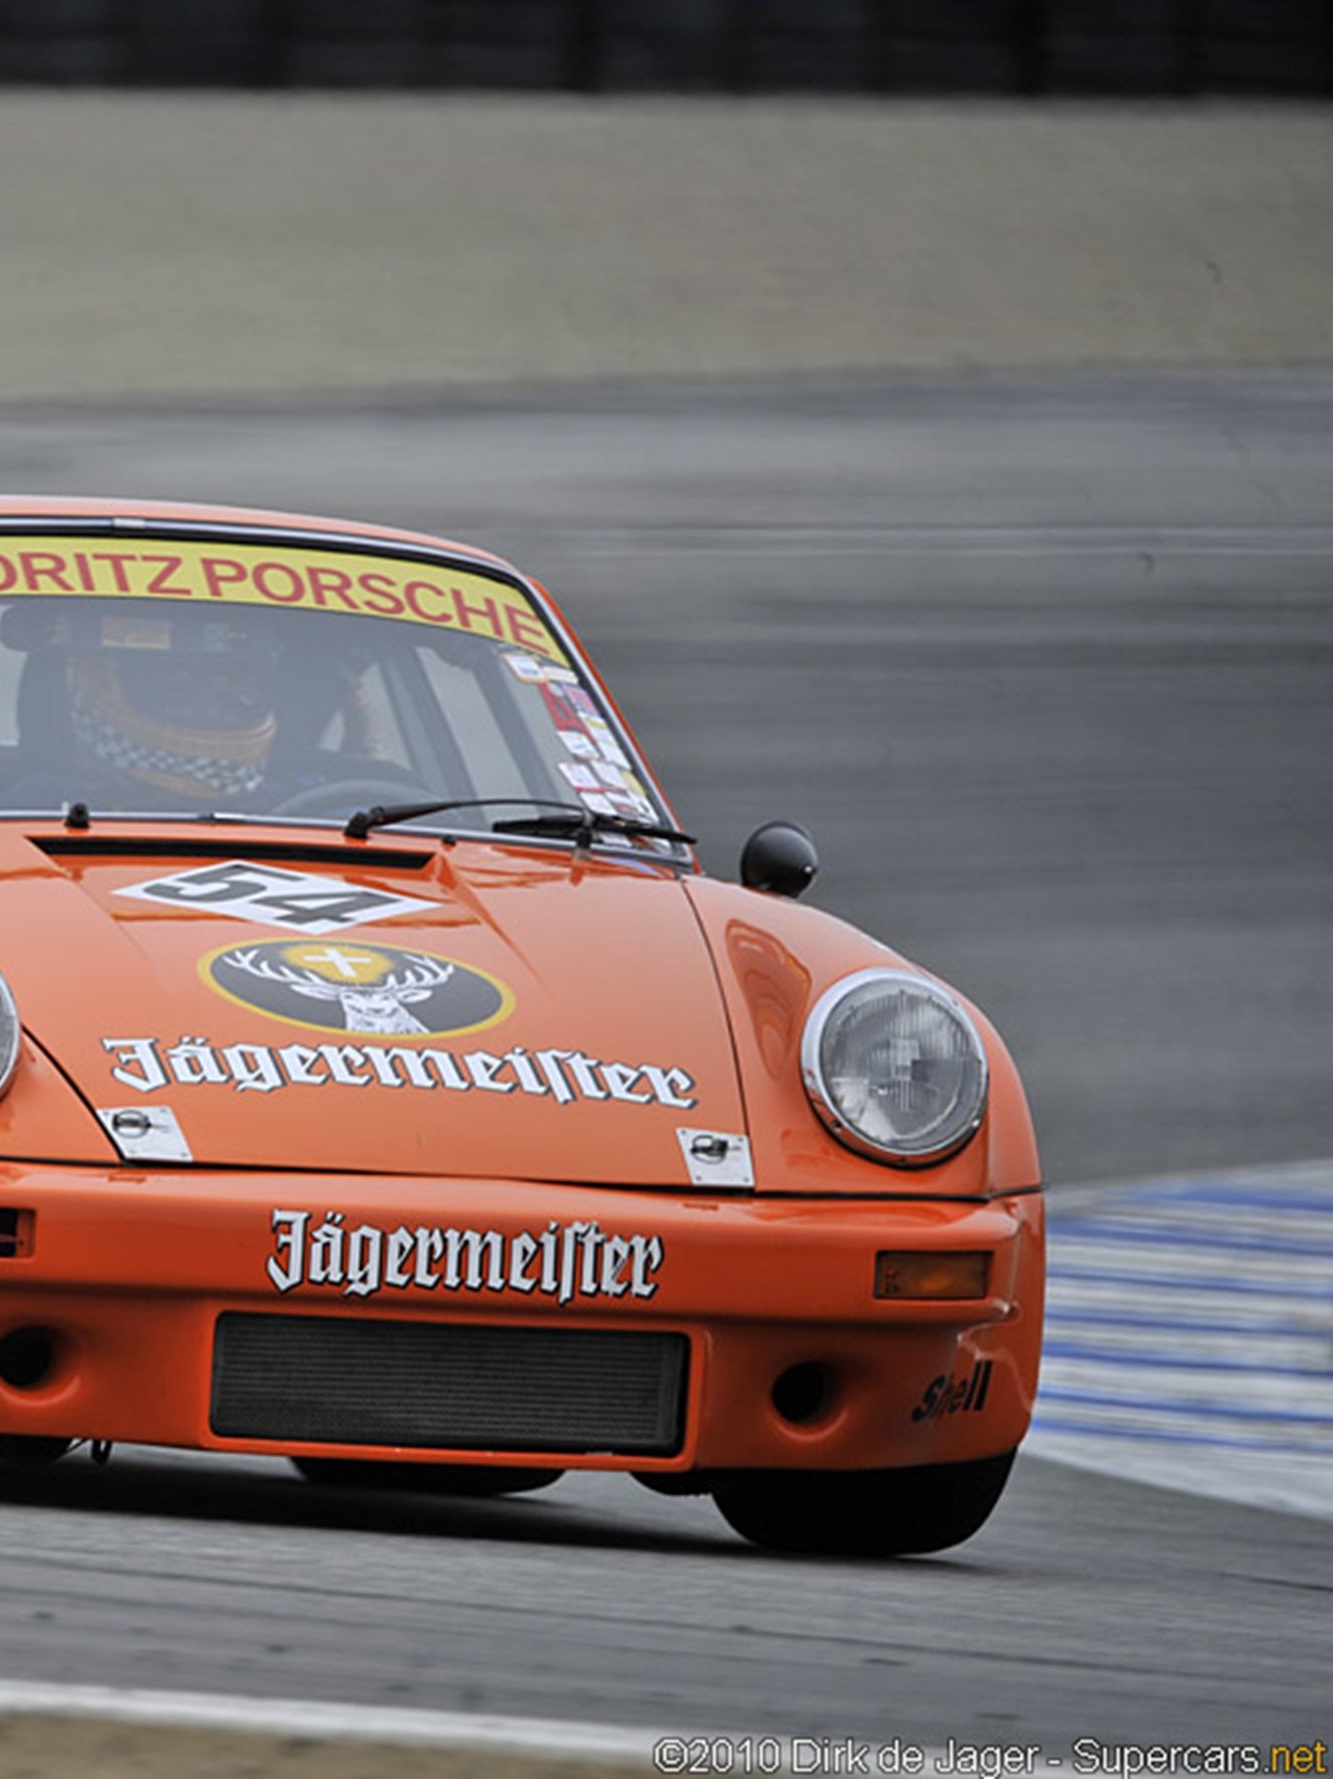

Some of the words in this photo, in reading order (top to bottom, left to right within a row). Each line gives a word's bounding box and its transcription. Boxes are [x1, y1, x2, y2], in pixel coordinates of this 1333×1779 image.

[200, 557, 551, 656] PORSCHE
[142, 864, 402, 925] 54
[911, 1359, 993, 1423] Shell
